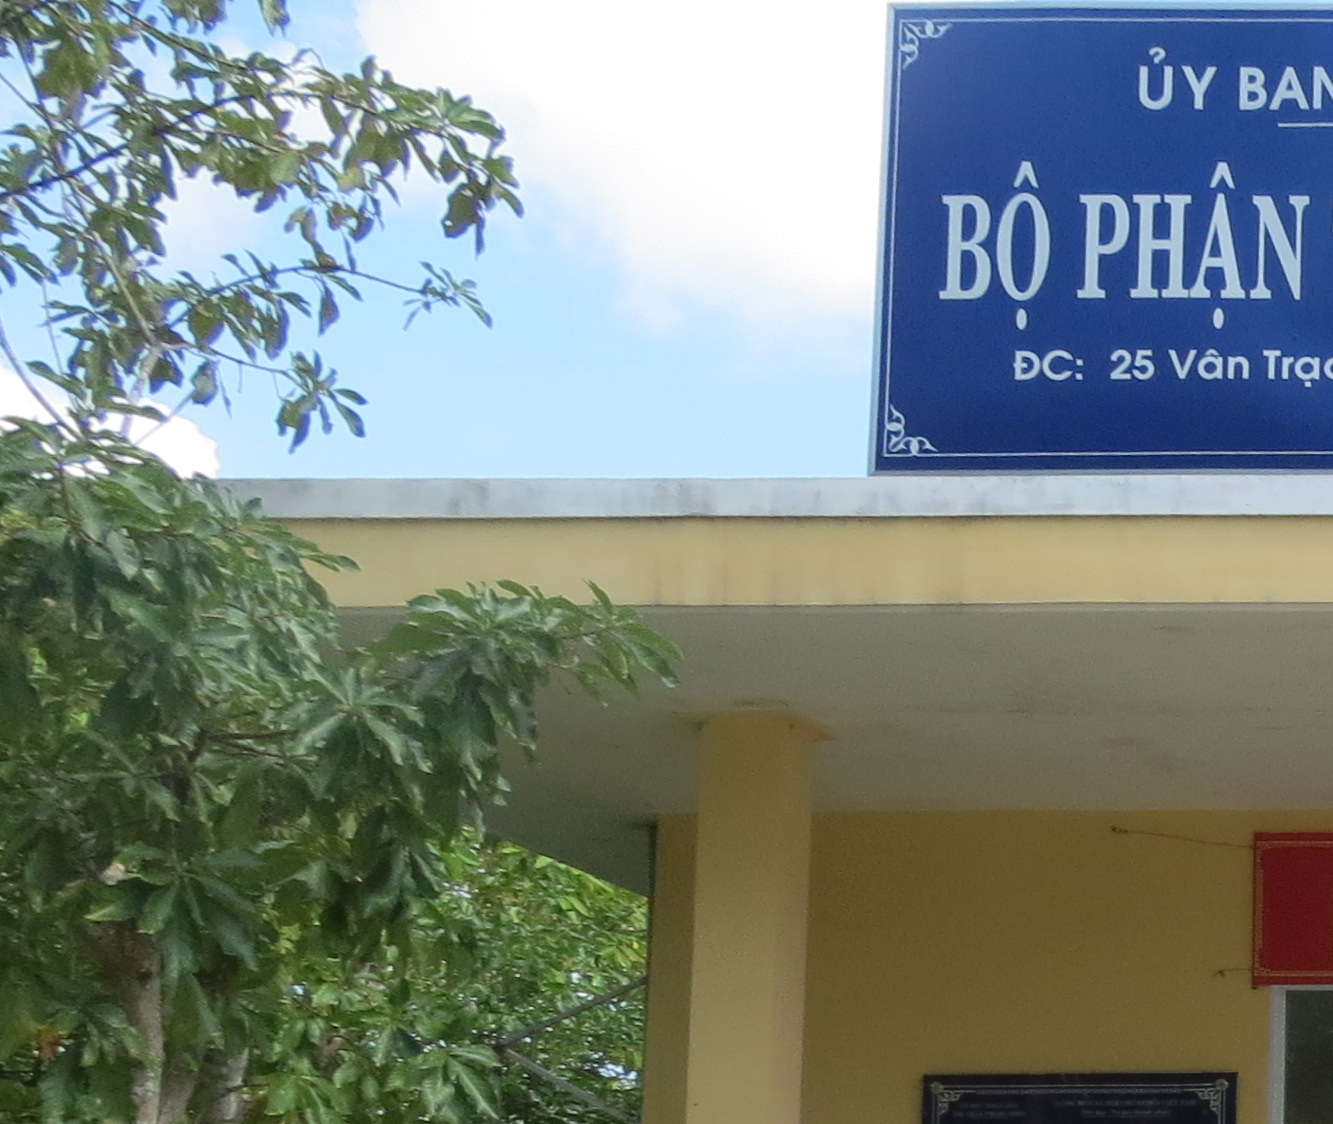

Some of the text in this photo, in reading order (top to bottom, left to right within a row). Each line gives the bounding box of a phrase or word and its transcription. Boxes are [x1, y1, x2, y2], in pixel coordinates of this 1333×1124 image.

[1139, 47, 1217, 109] ỦY
[939, 161, 1050, 329] BỘ
[1077, 162, 1310, 328] PHẬN
[1013, 350, 1083, 380] ĐC:
[1111, 350, 1154, 379] 25
[1168, 349, 1249, 379] Vân
